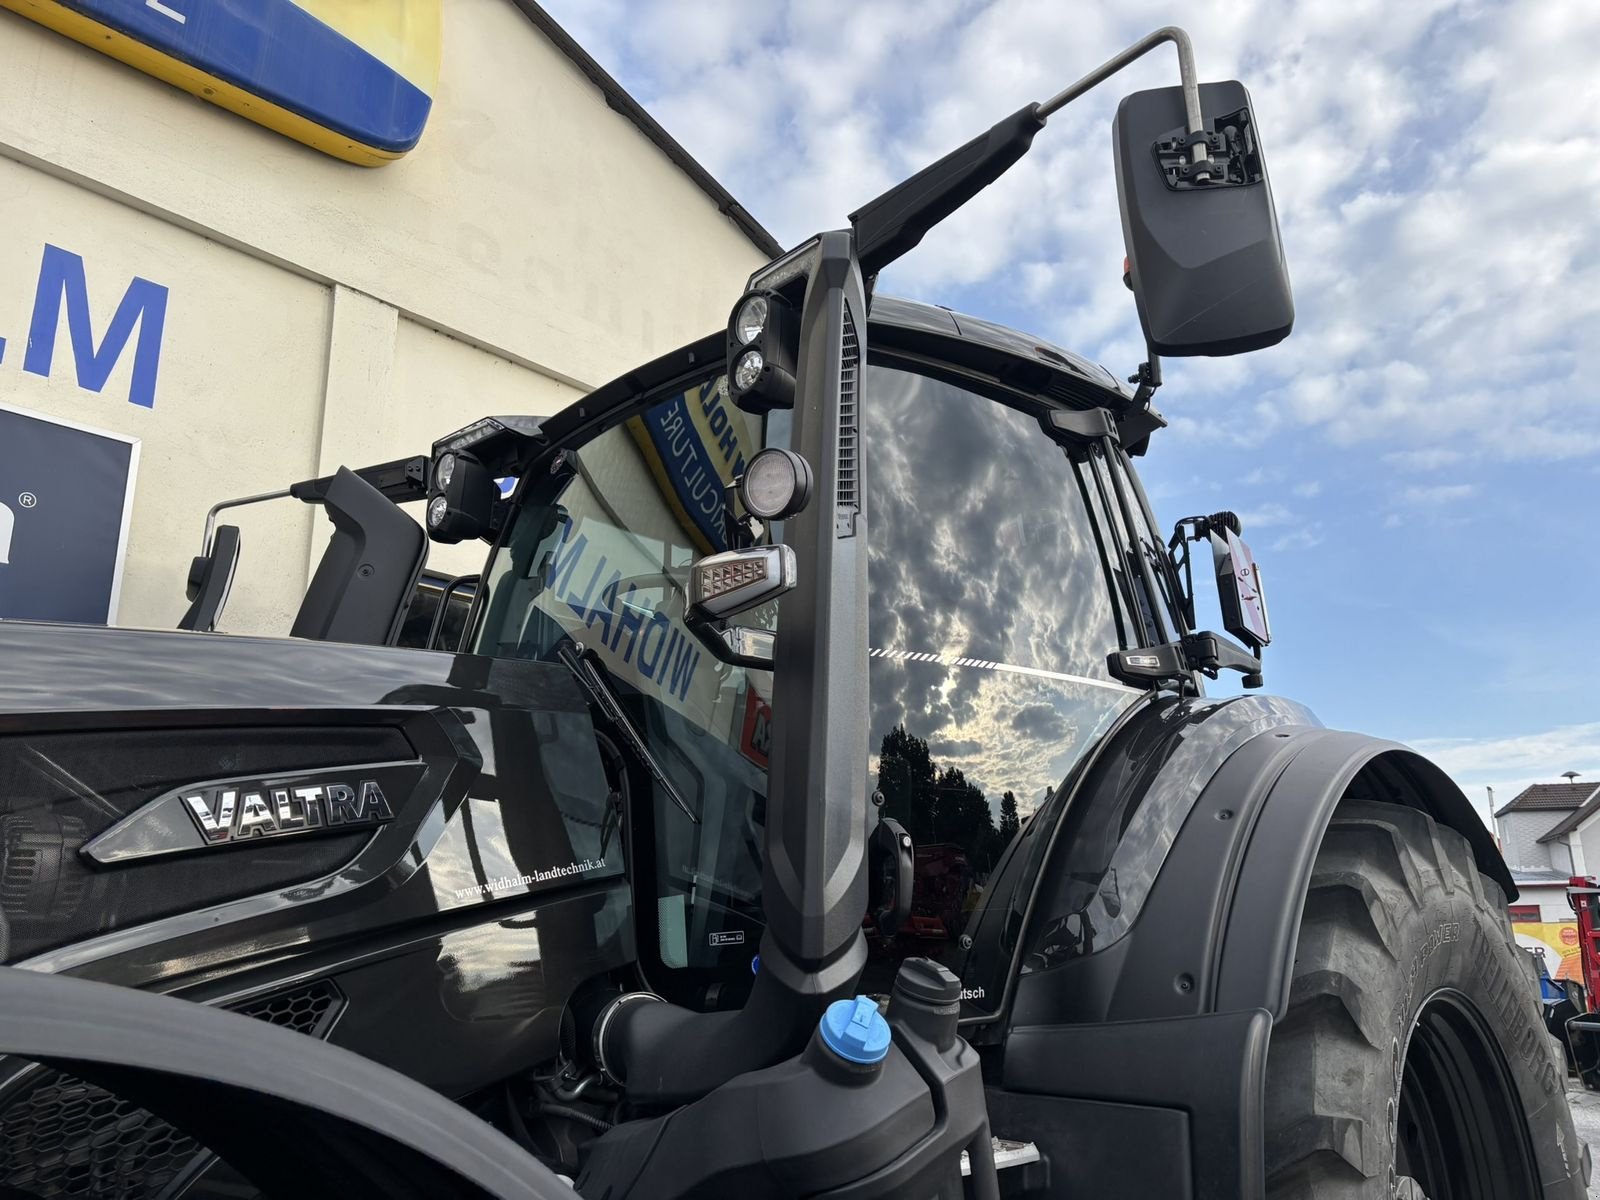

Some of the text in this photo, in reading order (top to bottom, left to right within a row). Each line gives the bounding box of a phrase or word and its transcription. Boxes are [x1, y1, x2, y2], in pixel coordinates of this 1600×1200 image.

[0, 243, 169, 409] M
[184, 780, 395, 842] VALTRA
[455, 858, 606, 899] www.widhalm-landtechnik.at
